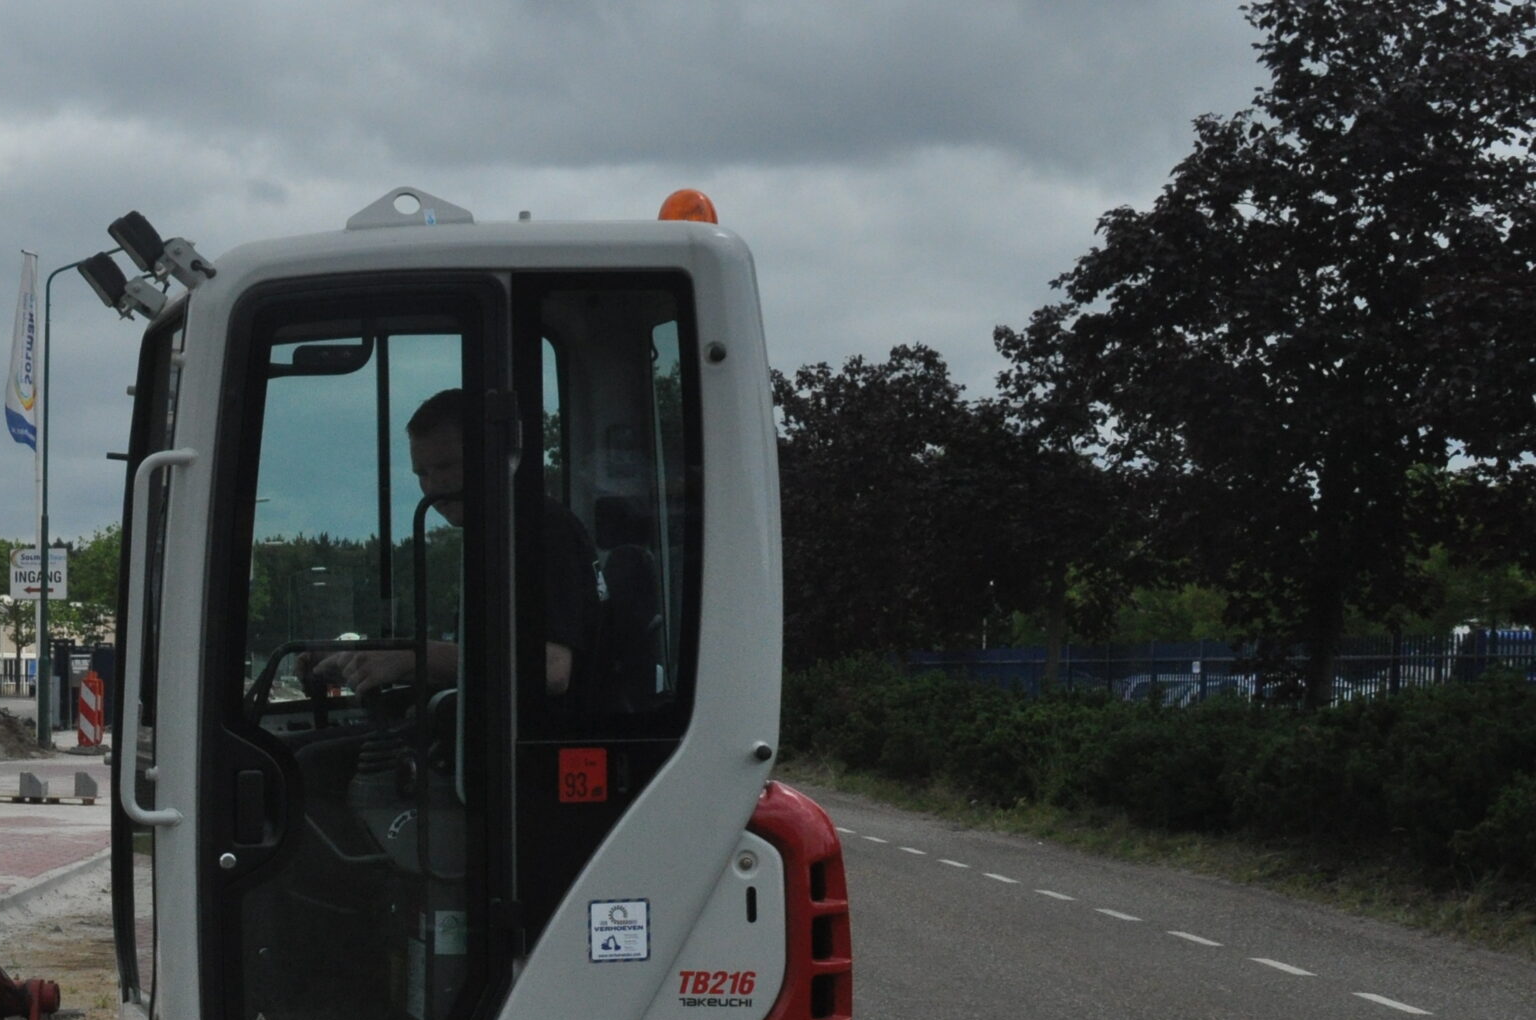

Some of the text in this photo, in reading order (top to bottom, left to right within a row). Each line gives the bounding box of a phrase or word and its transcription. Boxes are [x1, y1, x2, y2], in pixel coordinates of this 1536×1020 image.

[15, 570, 62, 583] INGANG
[565, 771, 587, 797] 93
[679, 970, 757, 995] TB216
[679, 998, 753, 1008] TAKEUCHI
